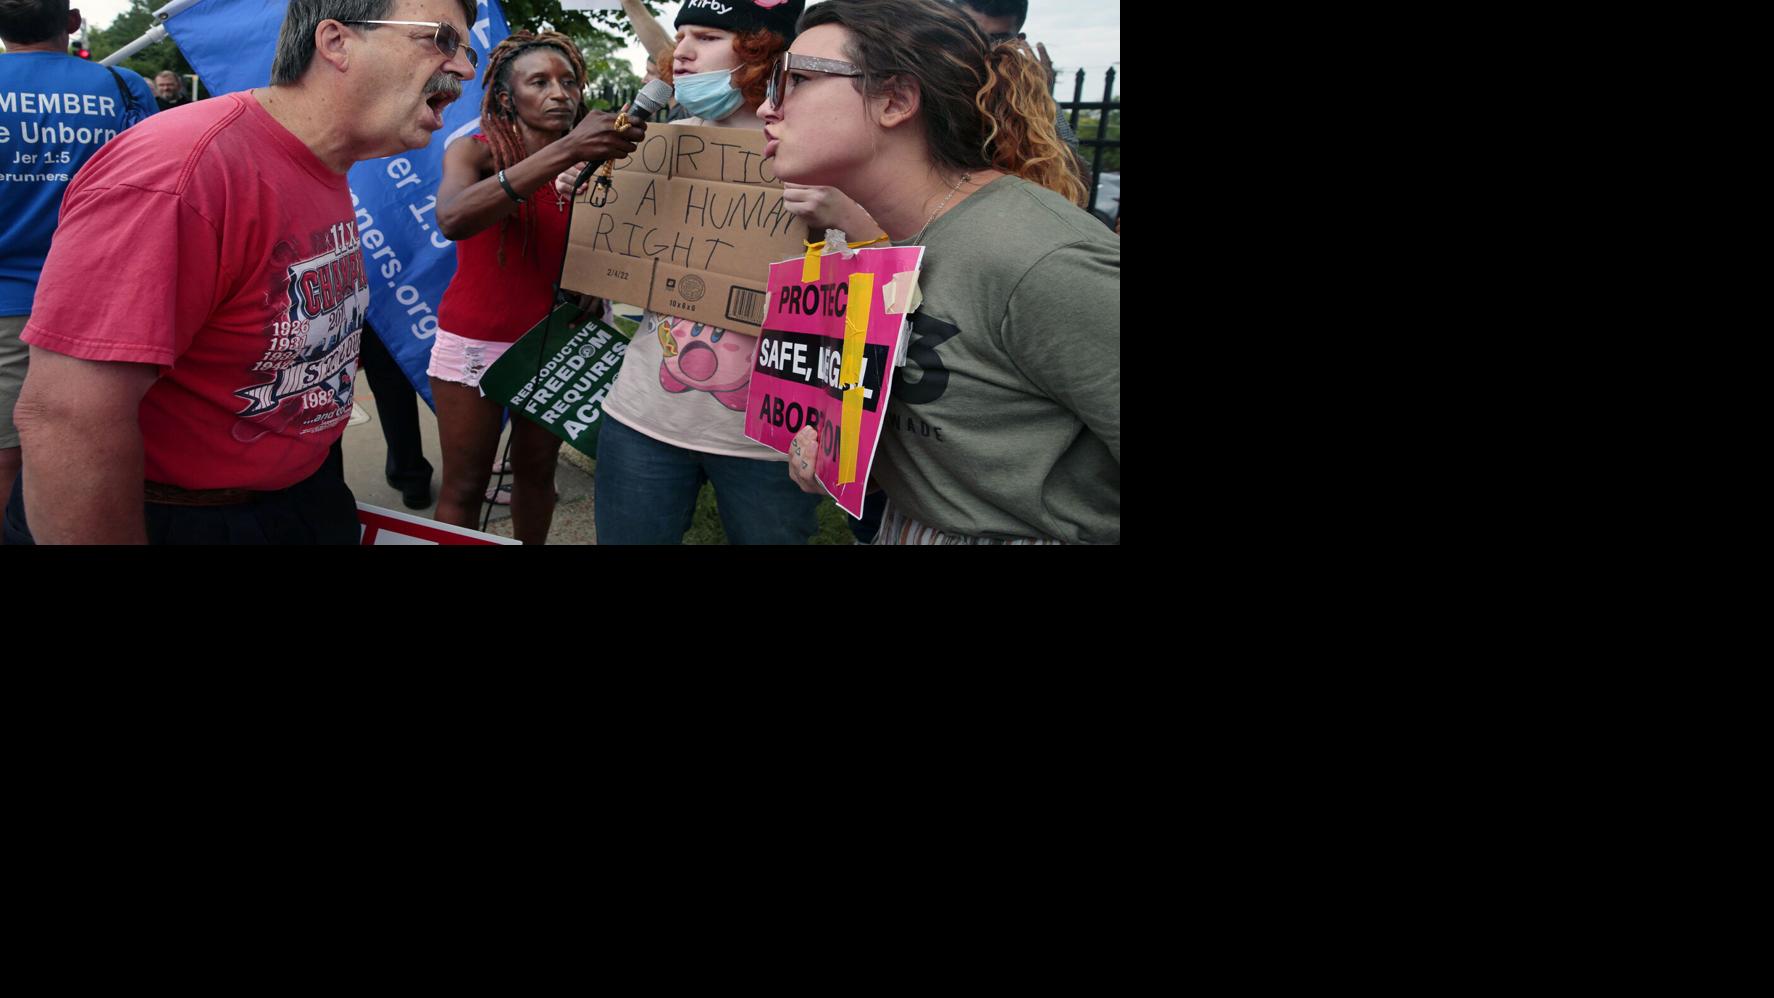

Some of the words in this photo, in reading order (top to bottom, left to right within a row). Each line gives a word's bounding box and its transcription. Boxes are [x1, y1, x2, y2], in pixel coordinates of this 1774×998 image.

[21, 121, 116, 144] Unborn
[13, 151, 38, 164] Jer
[44, 151, 70, 164] 1:5
[380, 156, 422, 189] er
[635, 179, 656, 216] A
[593, 213, 735, 270] RIGHT
[273, 320, 310, 336] 1926
[510, 321, 598, 405] REPRODUCTIVE
[524, 329, 613, 414] FREEDOM
[759, 338, 812, 381] SAFE,
[817, 347, 873, 399] LEGL
[302, 389, 335, 410] 1982
[540, 341, 629, 424] REQUIRES
